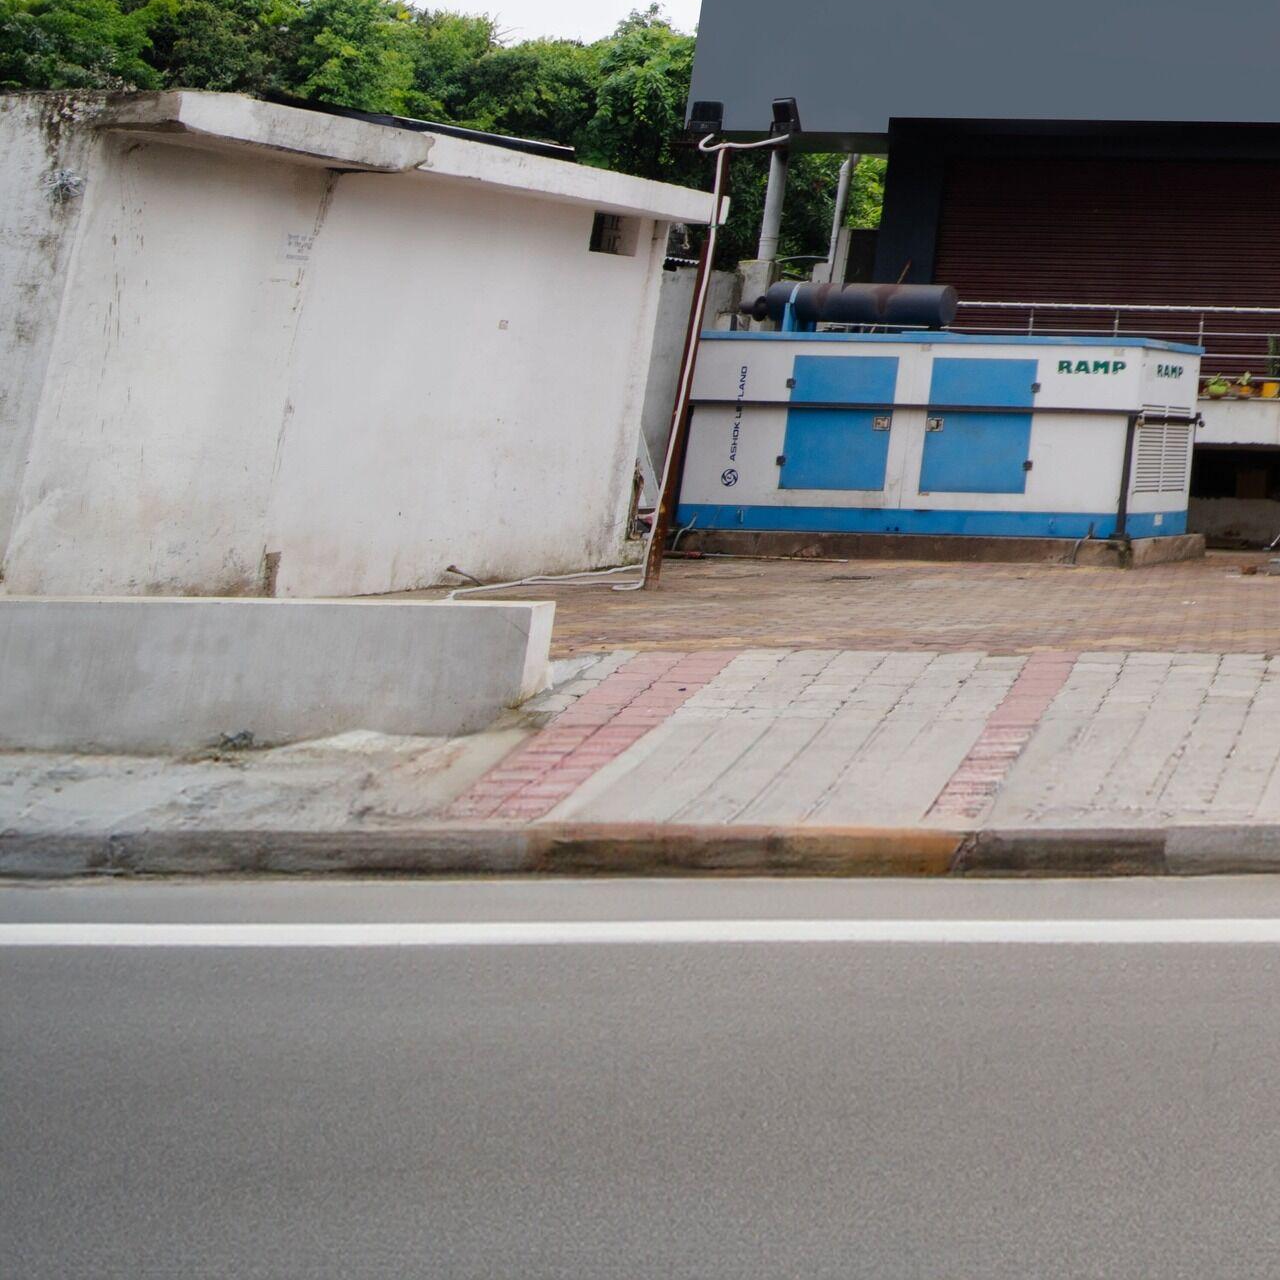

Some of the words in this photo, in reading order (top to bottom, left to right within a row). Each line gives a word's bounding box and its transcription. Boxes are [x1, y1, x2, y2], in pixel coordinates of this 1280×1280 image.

[1057, 360, 1127, 375] RAMP
[1156, 364, 1184, 378] RAMP
[729, 422, 740, 462] ASHOK
[735, 365, 748, 419] LELAND
